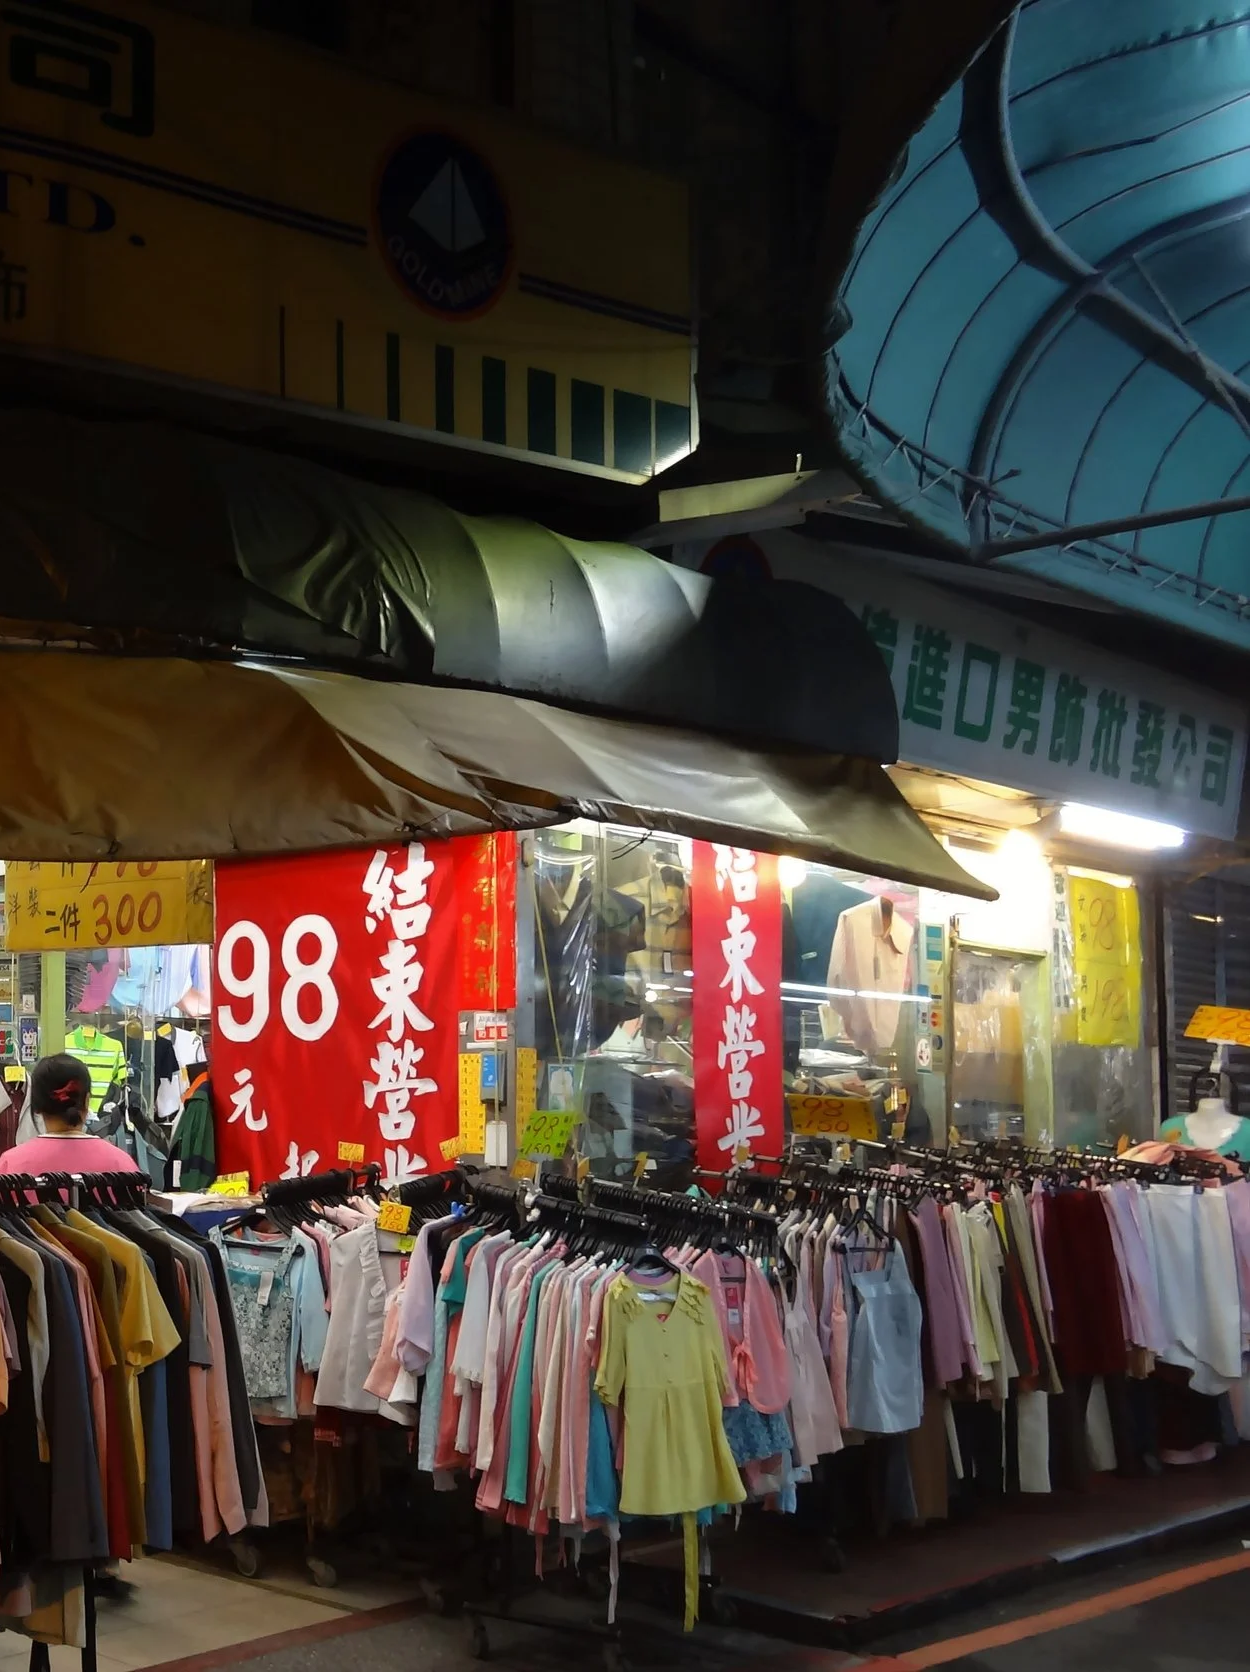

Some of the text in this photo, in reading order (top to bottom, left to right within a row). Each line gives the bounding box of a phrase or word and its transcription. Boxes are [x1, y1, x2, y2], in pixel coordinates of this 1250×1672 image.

[92, 891, 163, 946] 300
[217, 913, 339, 1043] 98
[227, 1067, 269, 1132] 元
[802, 1096, 846, 1118] 98
[532, 1115, 560, 1140] 98
[804, 1119, 850, 1133] 150
[385, 1205, 404, 1220] 98
[382, 1219, 404, 1231] 150
